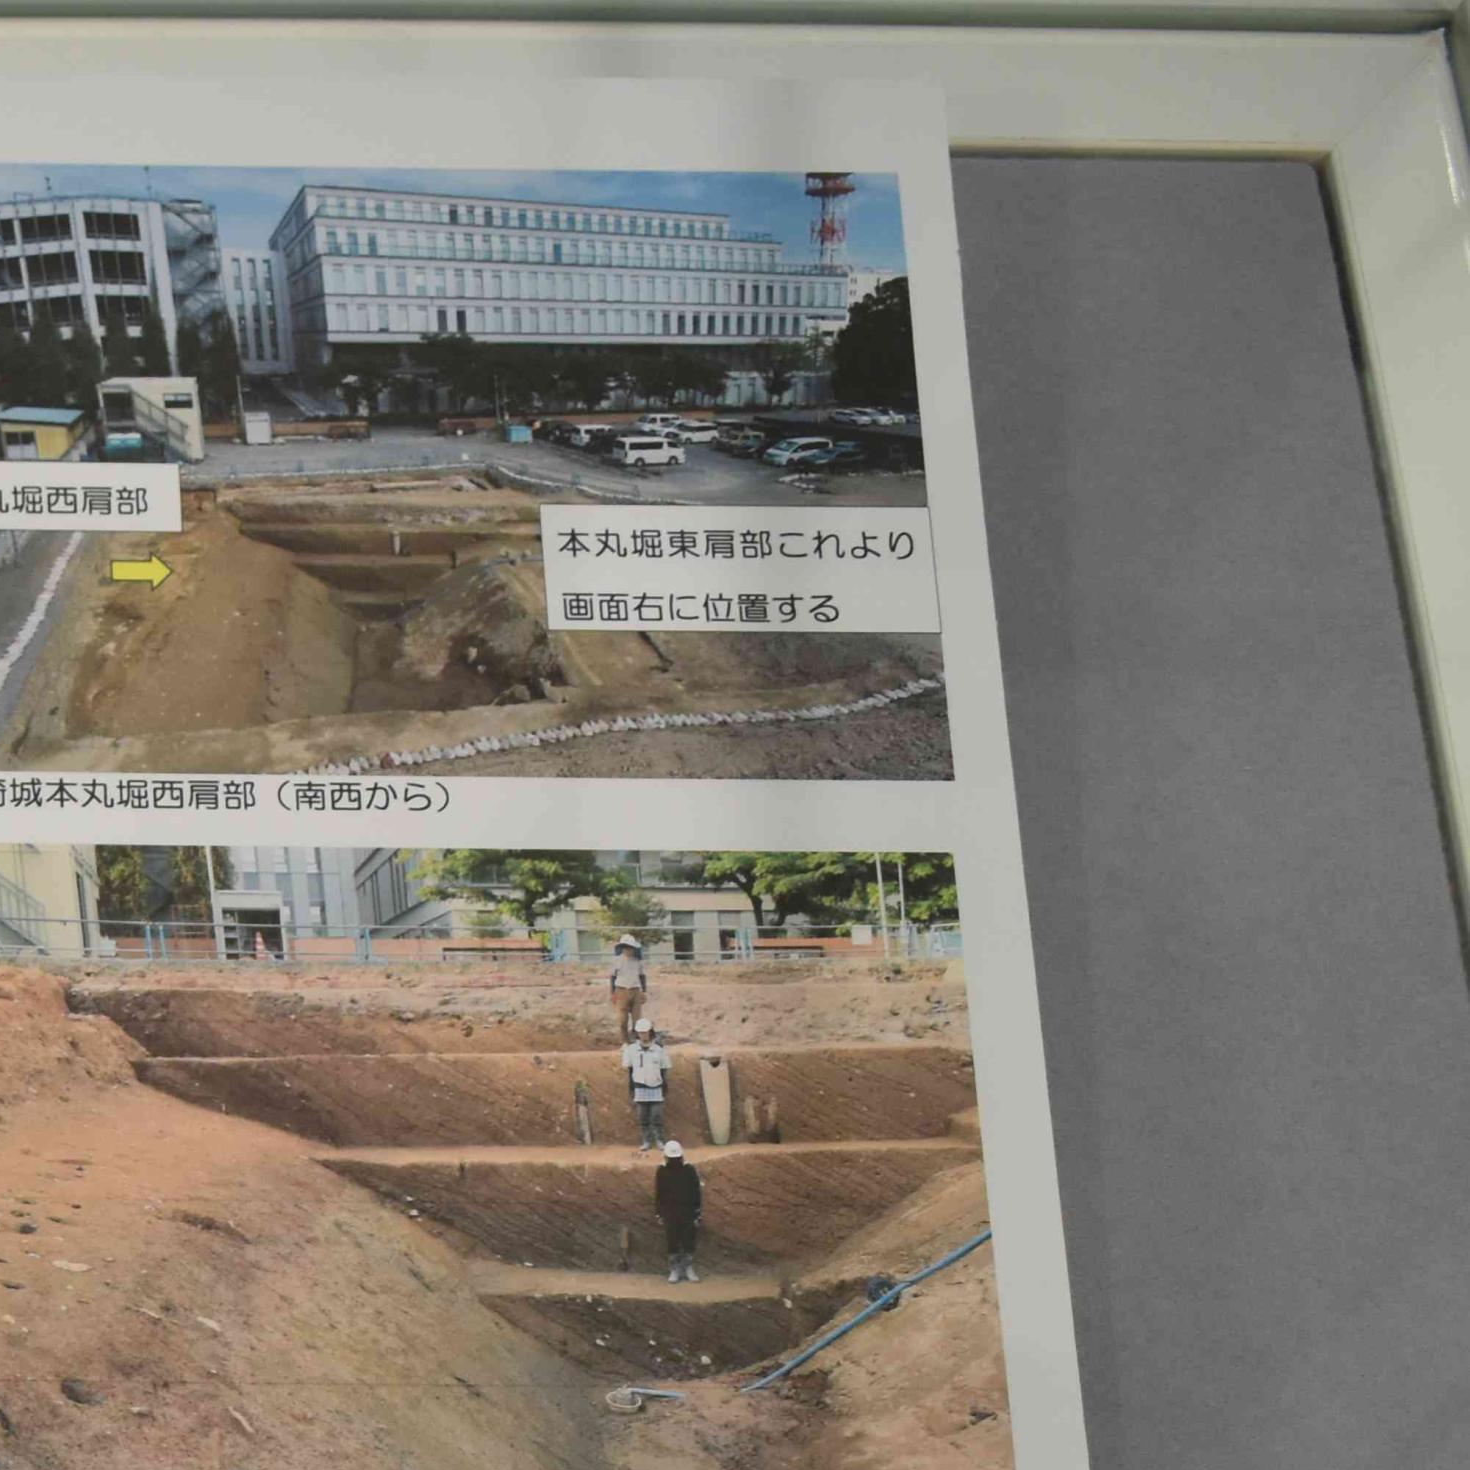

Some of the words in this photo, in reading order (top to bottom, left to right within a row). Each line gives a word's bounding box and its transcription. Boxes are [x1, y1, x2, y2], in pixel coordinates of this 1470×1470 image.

[558, 528, 914, 560] 本丸堀東肩部これより
[562, 592, 840, 624] 画面右に位置する
